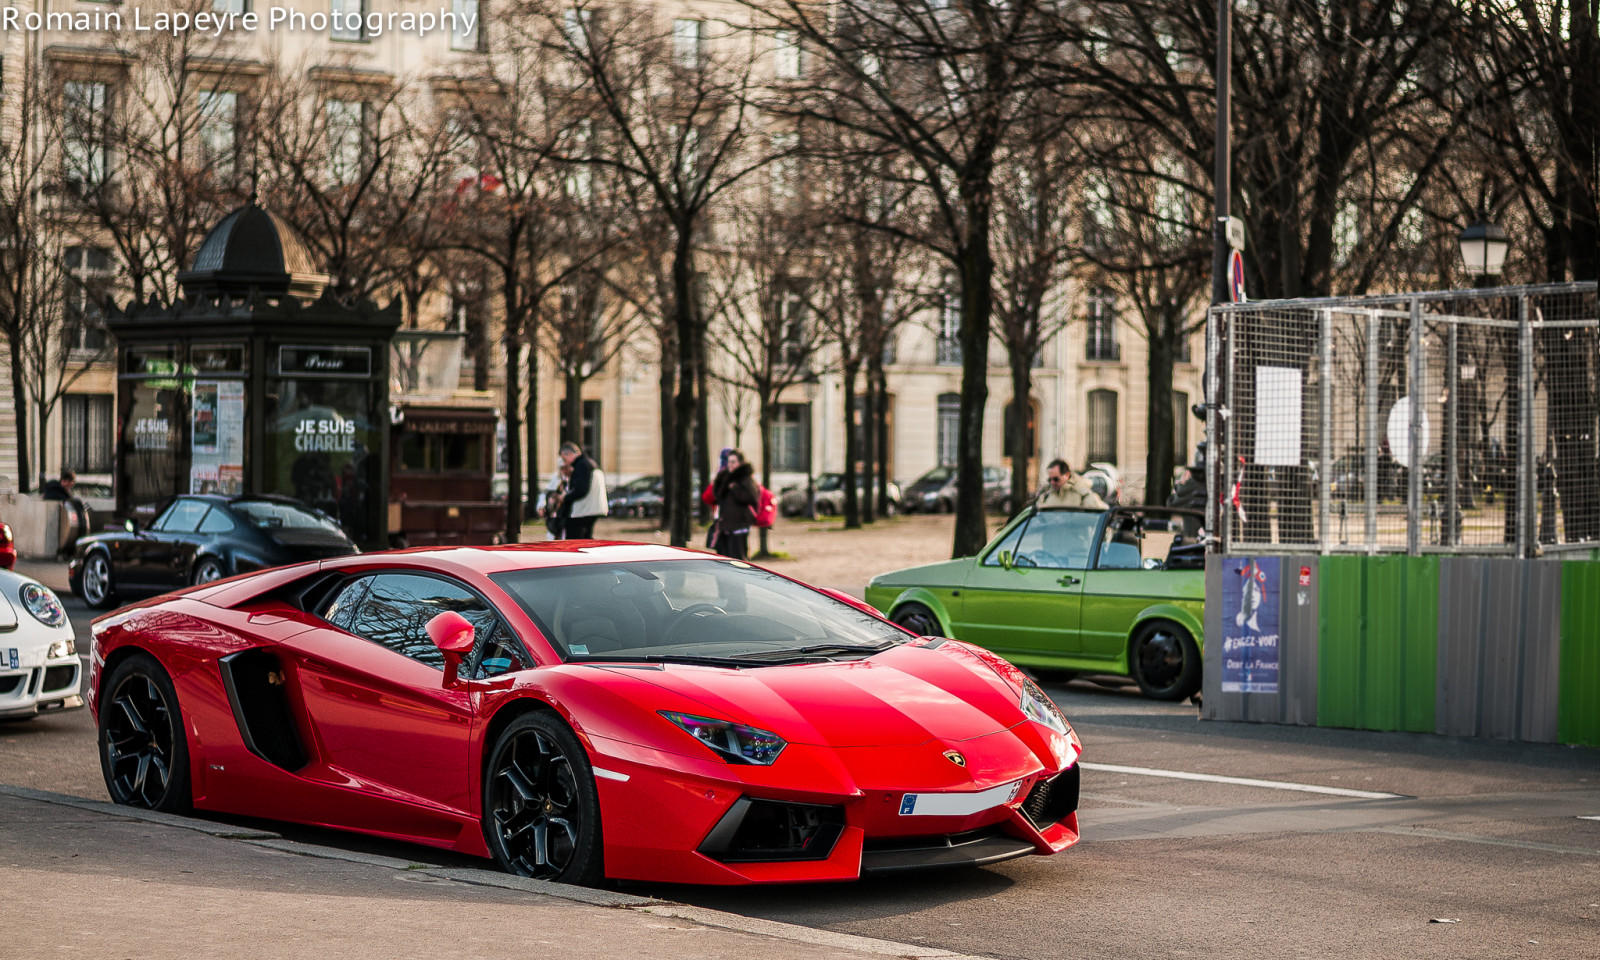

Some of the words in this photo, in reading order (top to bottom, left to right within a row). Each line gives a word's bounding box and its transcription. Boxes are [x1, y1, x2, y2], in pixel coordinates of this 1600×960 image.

[305, 353, 344, 369] Presse
[134, 418, 146, 433] JE
[147, 418, 168, 433] SUIS
[295, 419, 316, 434] JE
[318, 419, 356, 434] SUIS
[295, 434, 356, 452] CHARLIE
[1255, 659, 1279, 670] FRANCE
